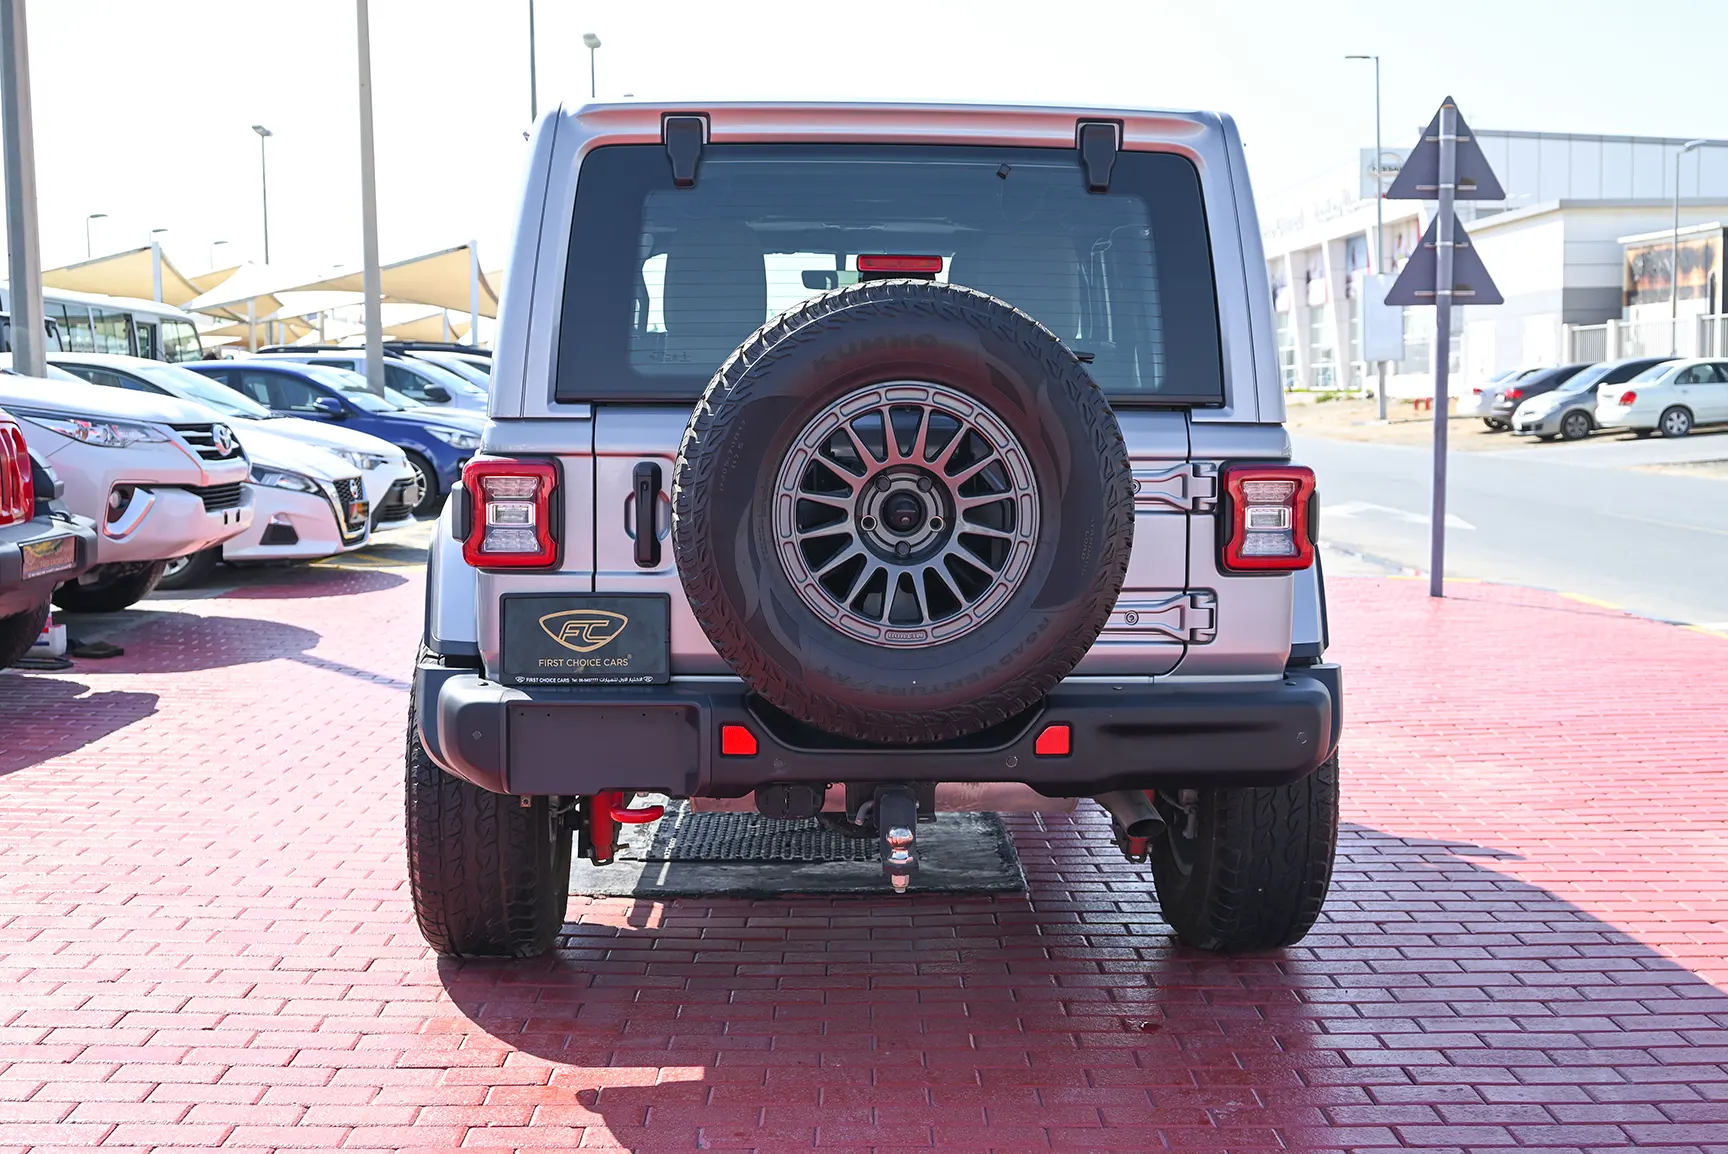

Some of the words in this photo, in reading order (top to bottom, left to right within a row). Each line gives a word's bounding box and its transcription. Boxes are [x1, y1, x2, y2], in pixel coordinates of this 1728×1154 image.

[811, 332, 939, 374] KUMHO
[558, 619, 610, 643] FC
[998, 615, 1052, 667] ROAD
[538, 658, 564, 667] FIRST
[566, 658, 602, 667] CHOICE
[603, 658, 629, 667] CARS
[874, 665, 998, 695] VENTURE
